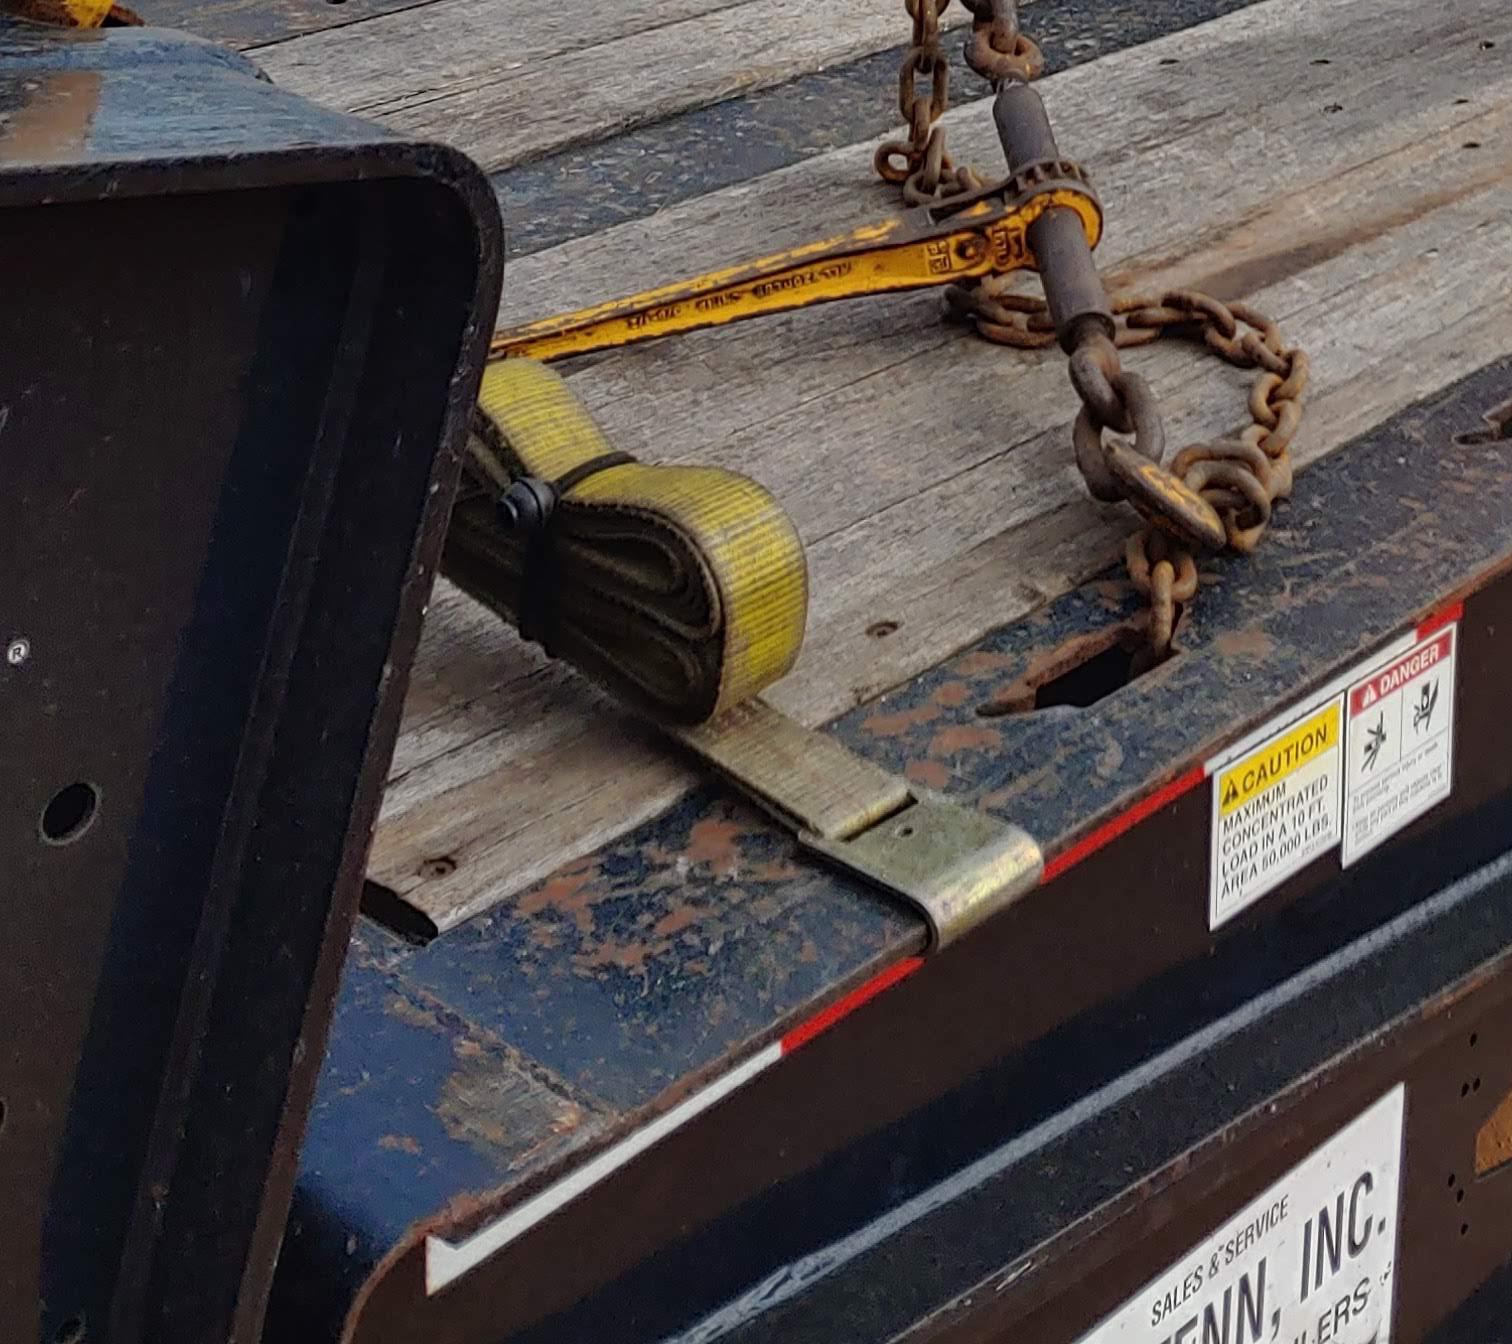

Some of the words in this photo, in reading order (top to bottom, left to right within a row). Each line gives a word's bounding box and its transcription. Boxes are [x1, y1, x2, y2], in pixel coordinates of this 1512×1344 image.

[1379, 643, 1440, 694] DANGER
[1242, 723, 1328, 794] CAUTION
[1222, 774, 1328, 857] CONCENTRATED
[1223, 781, 1286, 836] MAXIMUM
[1222, 842, 1258, 879] LOAD
[1262, 829, 1275, 850] IN
[1278, 823, 1287, 840] A
[1293, 809, 1305, 830] 10
[1221, 862, 1258, 900] AREA
[1151, 1264, 1204, 1328] SALES
[1208, 1252, 1220, 1279] &
[1225, 1194, 1289, 1266] SERVICE
[1300, 1171, 1386, 1304] INC.
